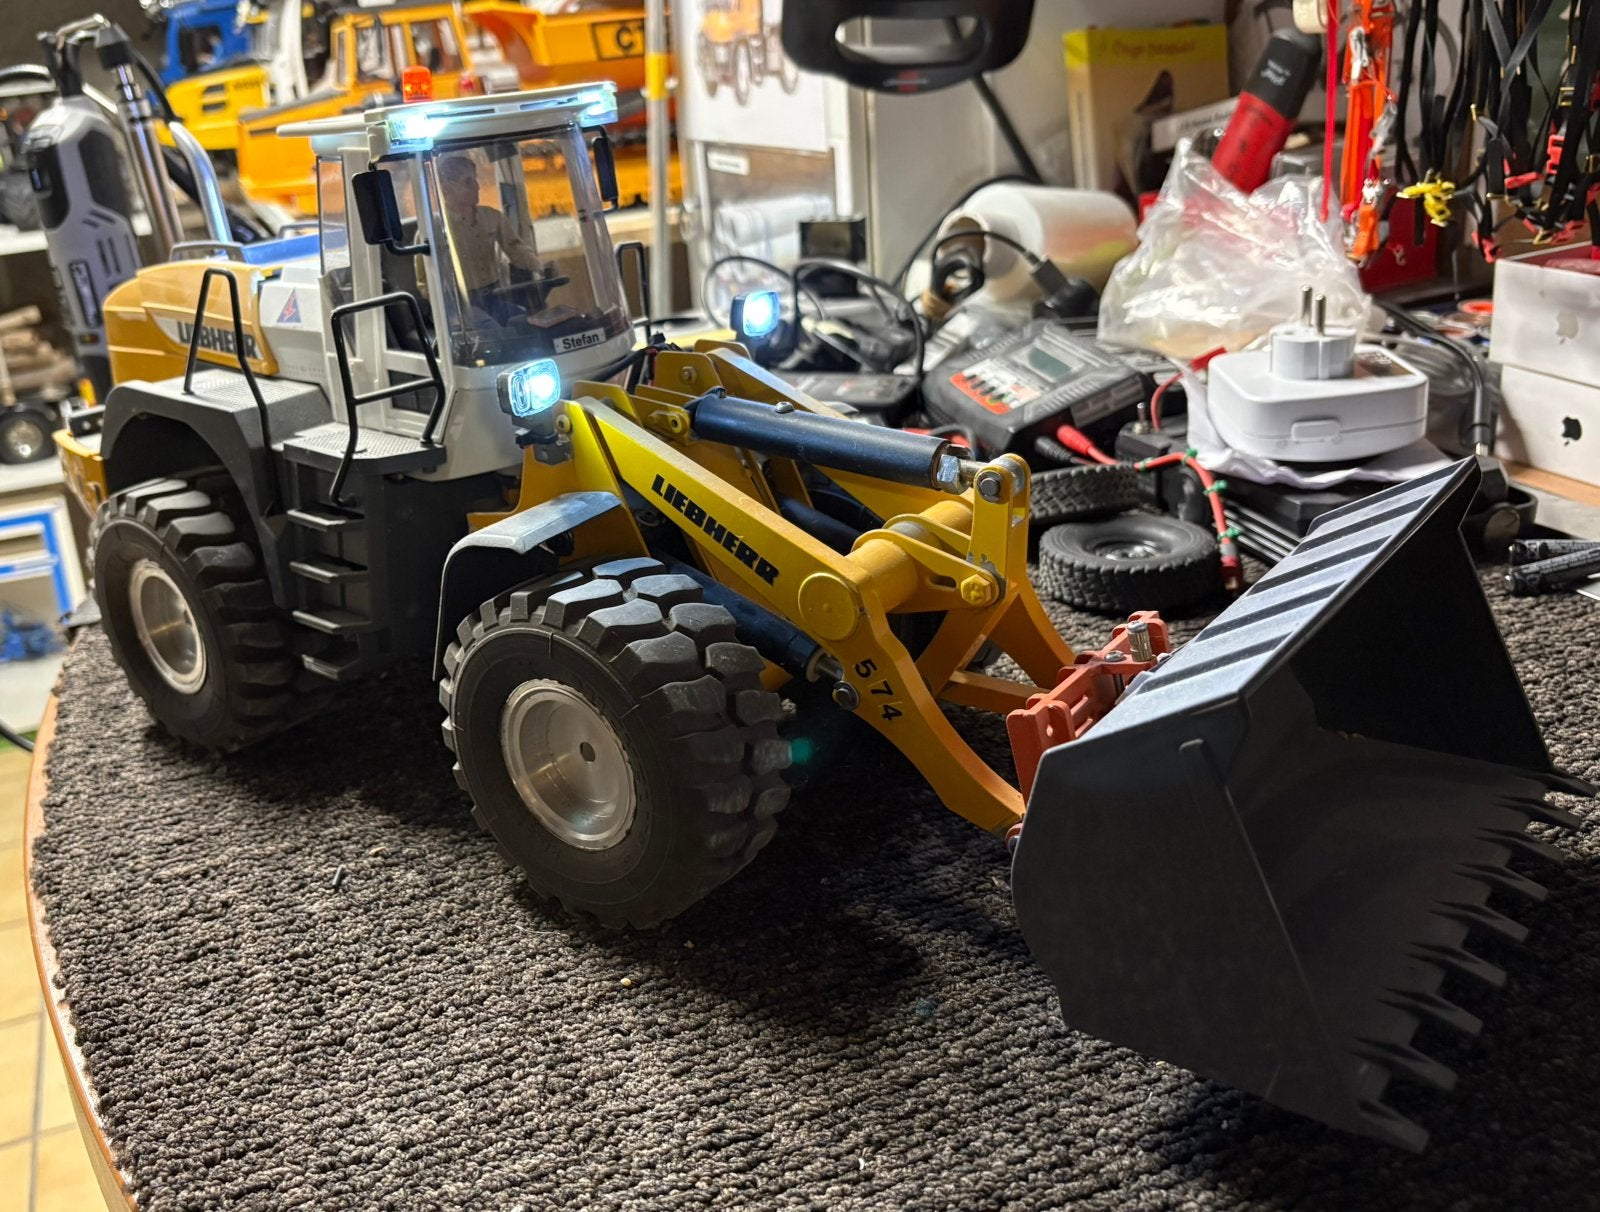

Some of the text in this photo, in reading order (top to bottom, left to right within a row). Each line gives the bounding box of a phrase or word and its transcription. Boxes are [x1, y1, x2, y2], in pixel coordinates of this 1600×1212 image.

[177, 320, 259, 358] LIBHER
[562, 333, 600, 349] Stefan
[651, 473, 779, 586] LIEBHERR
